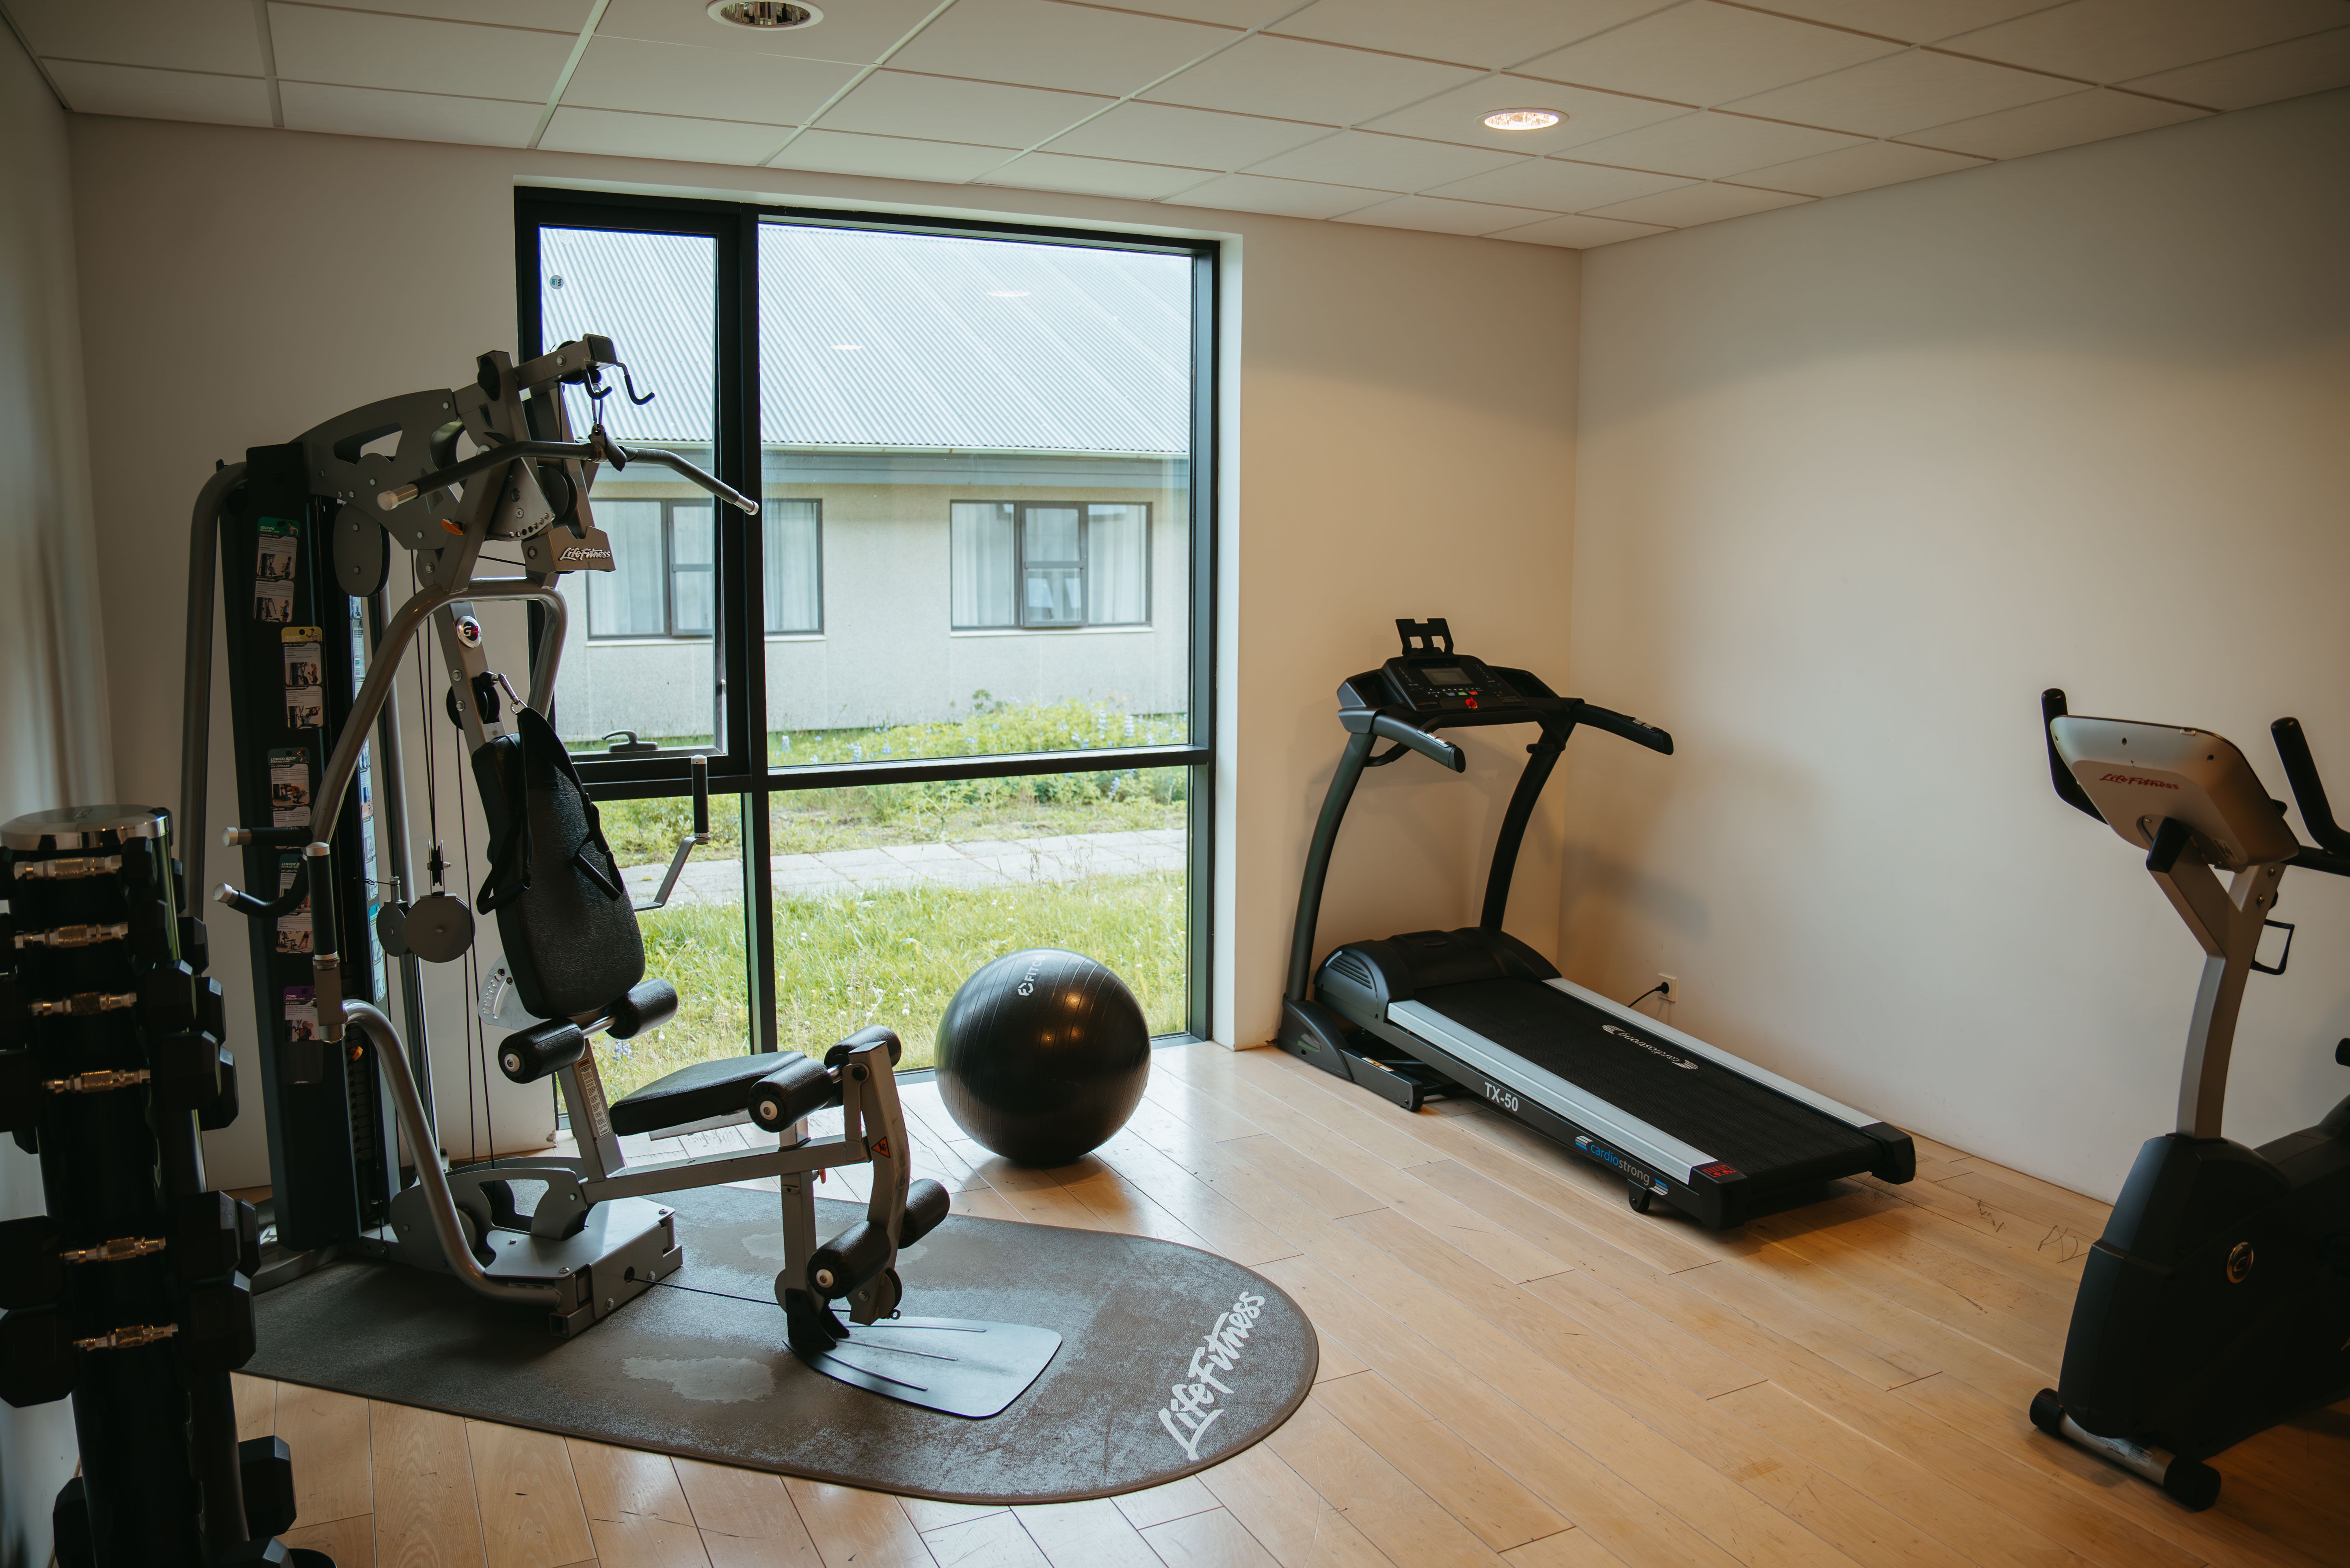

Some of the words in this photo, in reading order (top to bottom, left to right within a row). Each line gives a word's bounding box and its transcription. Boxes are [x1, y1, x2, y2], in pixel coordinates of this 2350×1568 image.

[463, 626, 480, 636] G4
[1024, 956, 1046, 982] FITCO
[1617, 1032, 1680, 1062] cardiostrong
[1485, 1081, 1518, 1112] TX-50
[1591, 1144, 1650, 1186] cardiostrong
